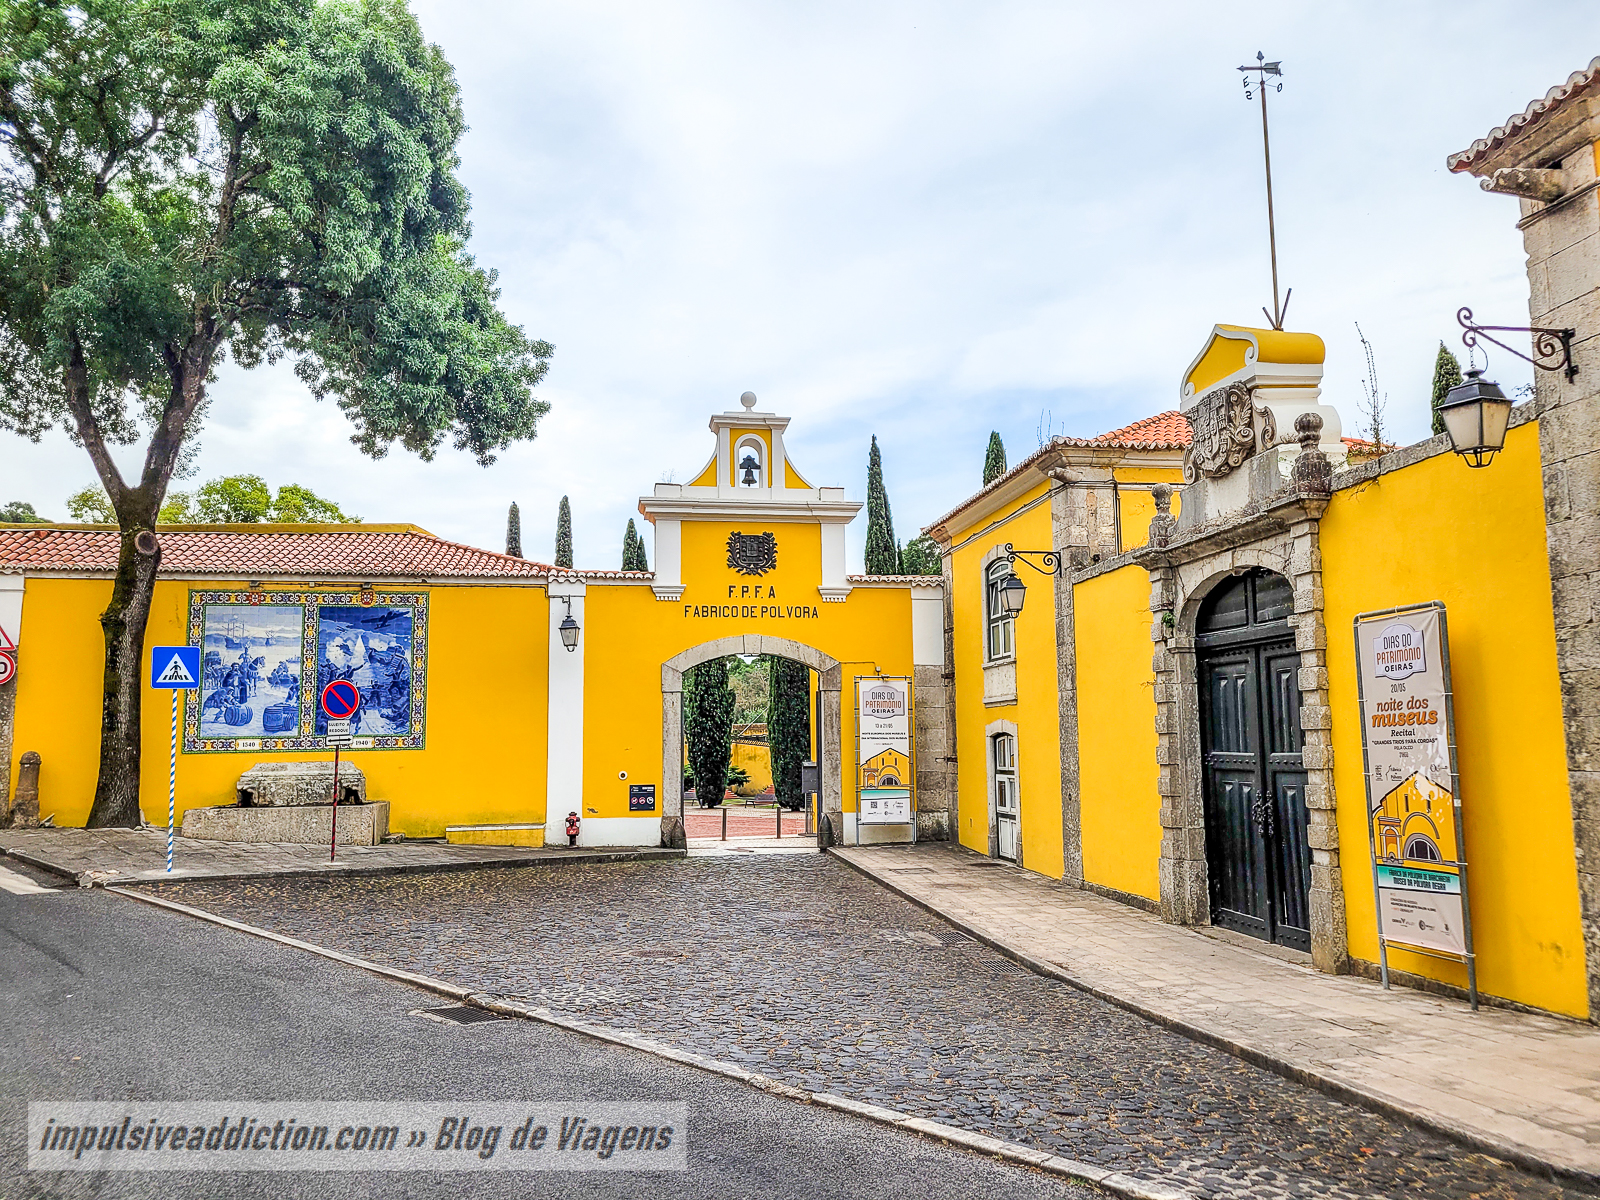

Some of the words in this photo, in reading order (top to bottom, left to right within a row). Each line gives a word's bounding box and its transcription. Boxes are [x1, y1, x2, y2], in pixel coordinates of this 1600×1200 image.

[684, 605, 739, 618] FABRICO
[742, 606, 758, 618] DE
[760, 606, 819, 619] POLVORA
[1383, 634, 1400, 650] DIAS
[1402, 632, 1412, 648] DO
[1376, 646, 1421, 666] PATRIMÓNIO
[1384, 662, 1414, 673] OEIRAS
[1390, 682, 1406, 693] 20/05
[871, 692, 886, 700] DIAS
[886, 692, 896, 700] DO
[1376, 698, 1403, 713] noite
[1406, 695, 1429, 710] dos
[1371, 710, 1438, 728] museus
[1390, 728, 1415, 737] Recital
